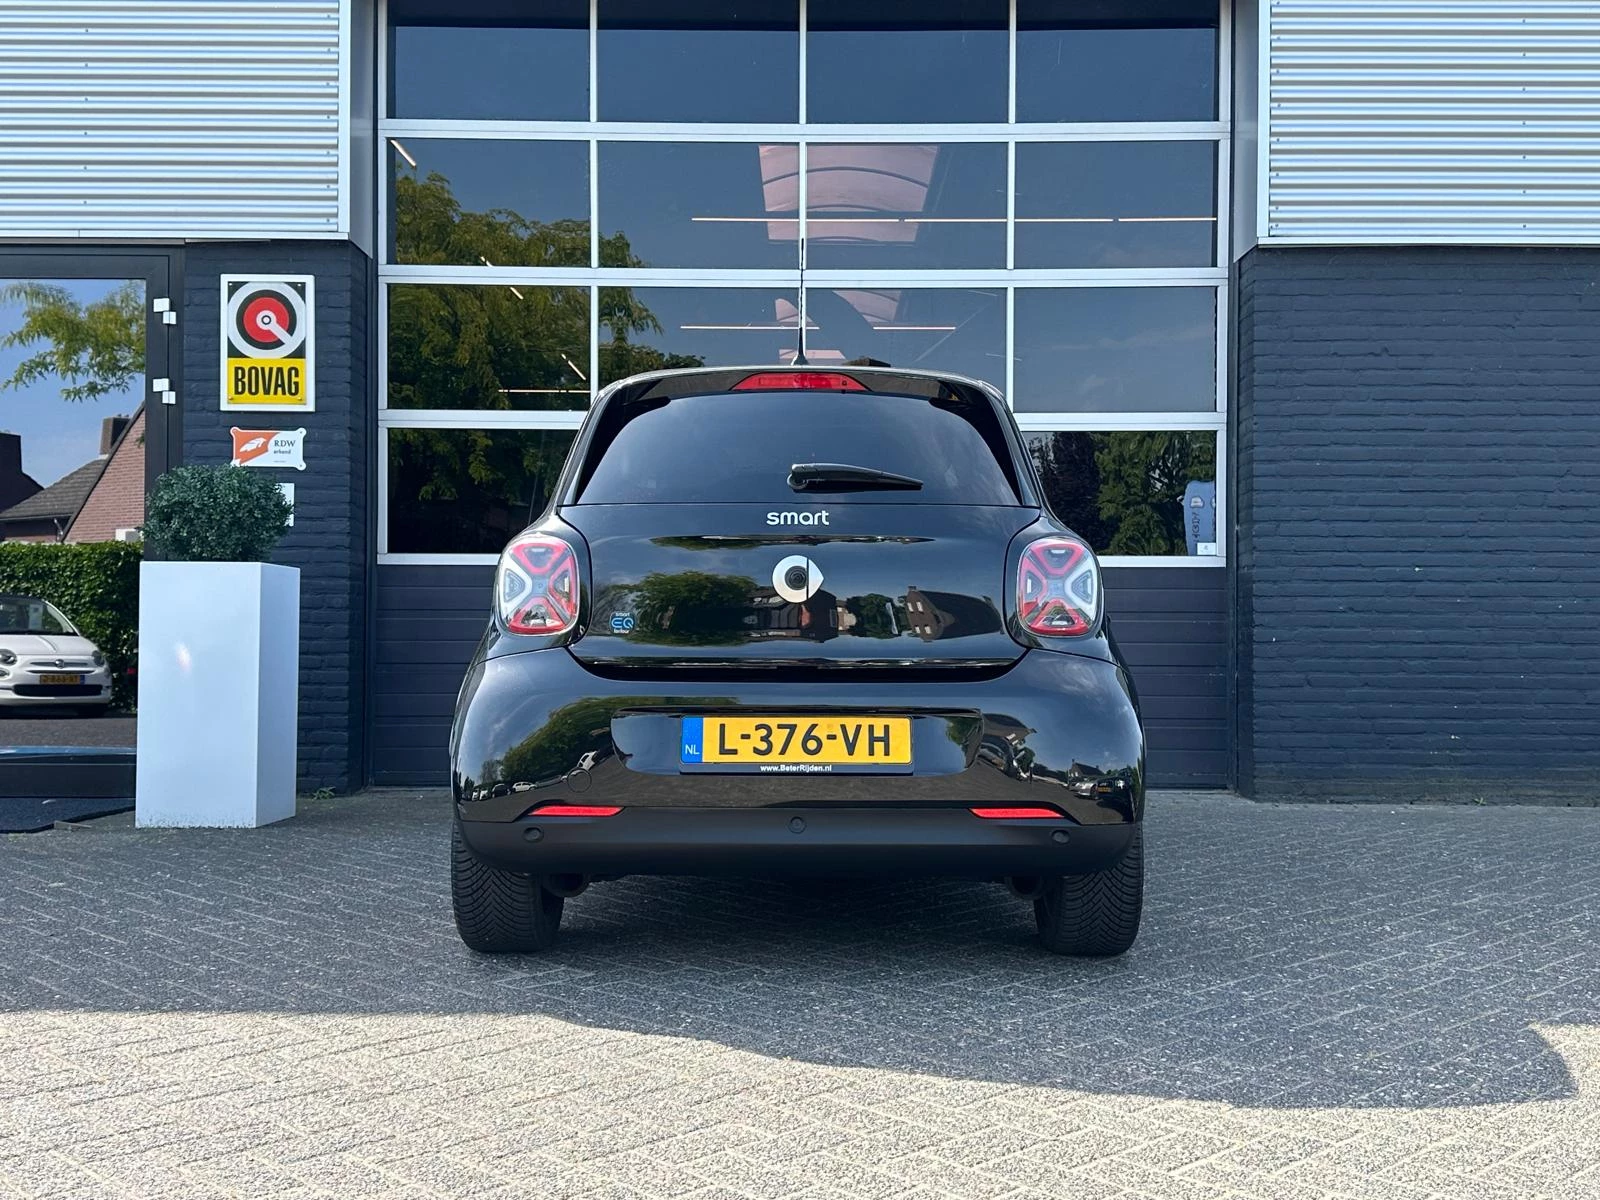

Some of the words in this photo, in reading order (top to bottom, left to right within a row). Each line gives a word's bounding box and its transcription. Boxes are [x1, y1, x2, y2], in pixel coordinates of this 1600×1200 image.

[234, 366, 299, 395] BOVAG
[766, 510, 829, 525] smart
[611, 617, 634, 629] EQ
[718, 723, 891, 756] L-376-VH
[685, 744, 700, 754] NL
[760, 764, 832, 773] www.BeterRijden.nl
